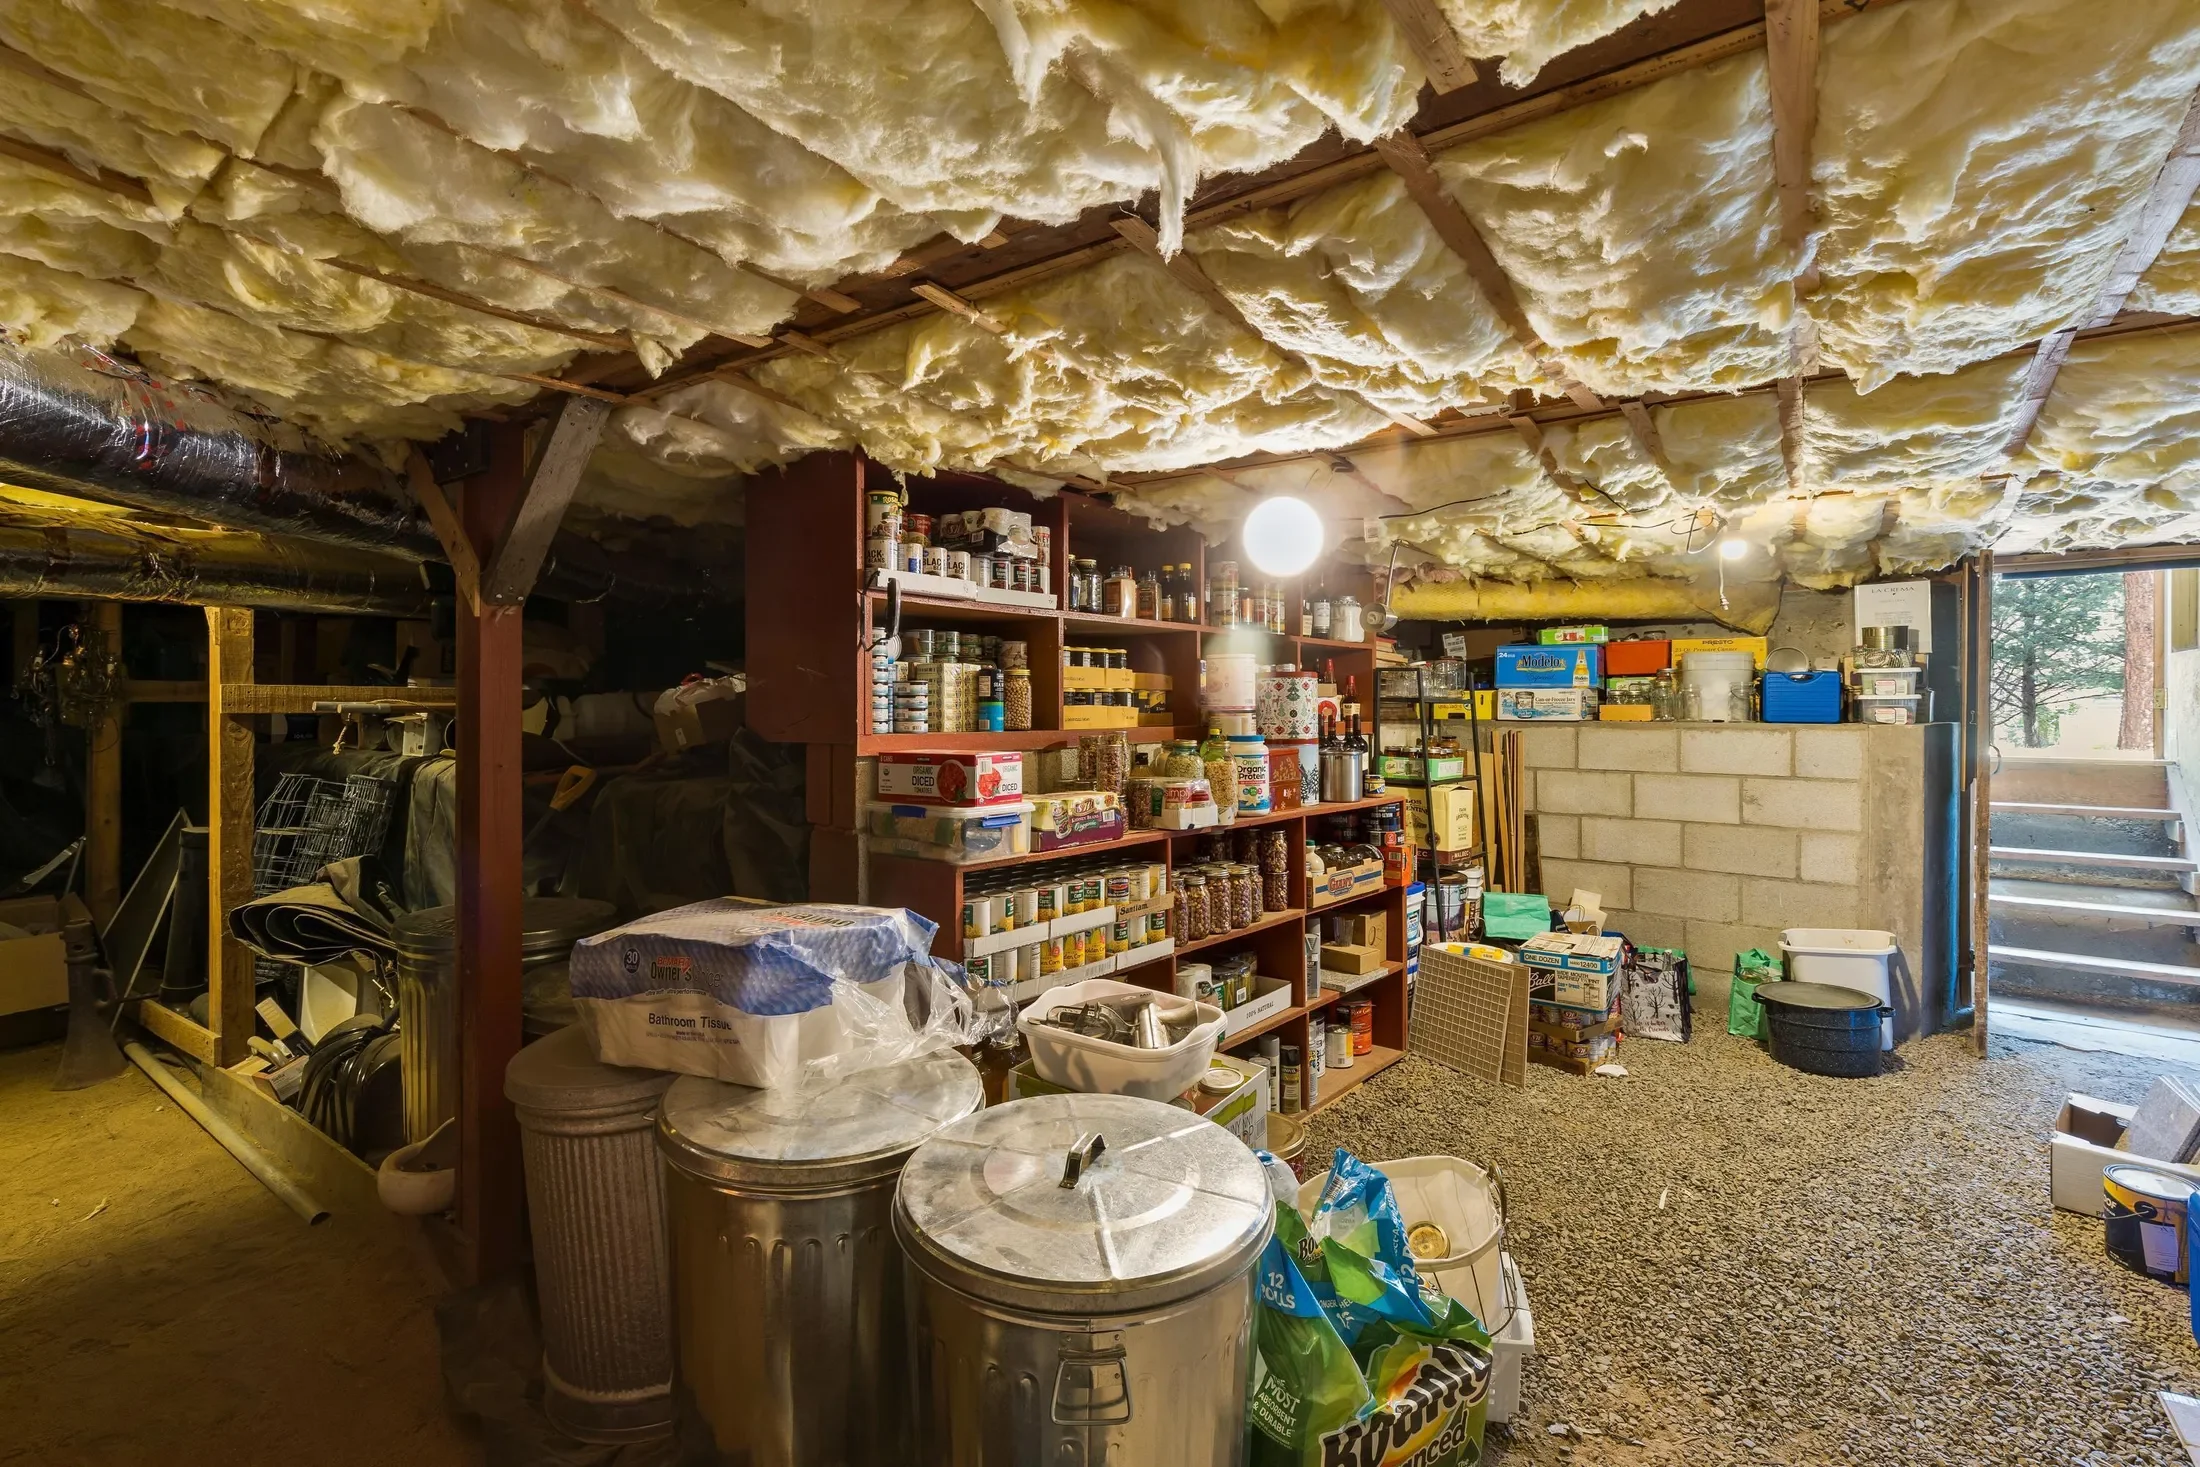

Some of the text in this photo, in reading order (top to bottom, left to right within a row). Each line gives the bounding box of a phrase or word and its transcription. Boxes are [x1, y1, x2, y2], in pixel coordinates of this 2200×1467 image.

[1522, 654, 1560, 667] Modelo
[912, 765, 934, 776] ORGANIC
[1237, 765, 1267, 775] Organic
[911, 775, 935, 787] DICED
[1001, 782, 1018, 792] DICED
[625, 951, 638, 964] 30
[1524, 953, 1560, 964] ONE DOZEN
[1529, 971, 1555, 987] Ball
[1257, 1000, 1274, 1014] NATURAL
[648, 1013, 696, 1028] Bathroom
[1268, 1271, 1285, 1289] 12
[1264, 1375, 1301, 1414] MOST
[1252, 1401, 1259, 1411] &
[1320, 1337, 1494, 1467] Bounty
[1257, 1391, 1297, 1427] ABSORBENT
[1402, 1408, 1469, 1467] anced
